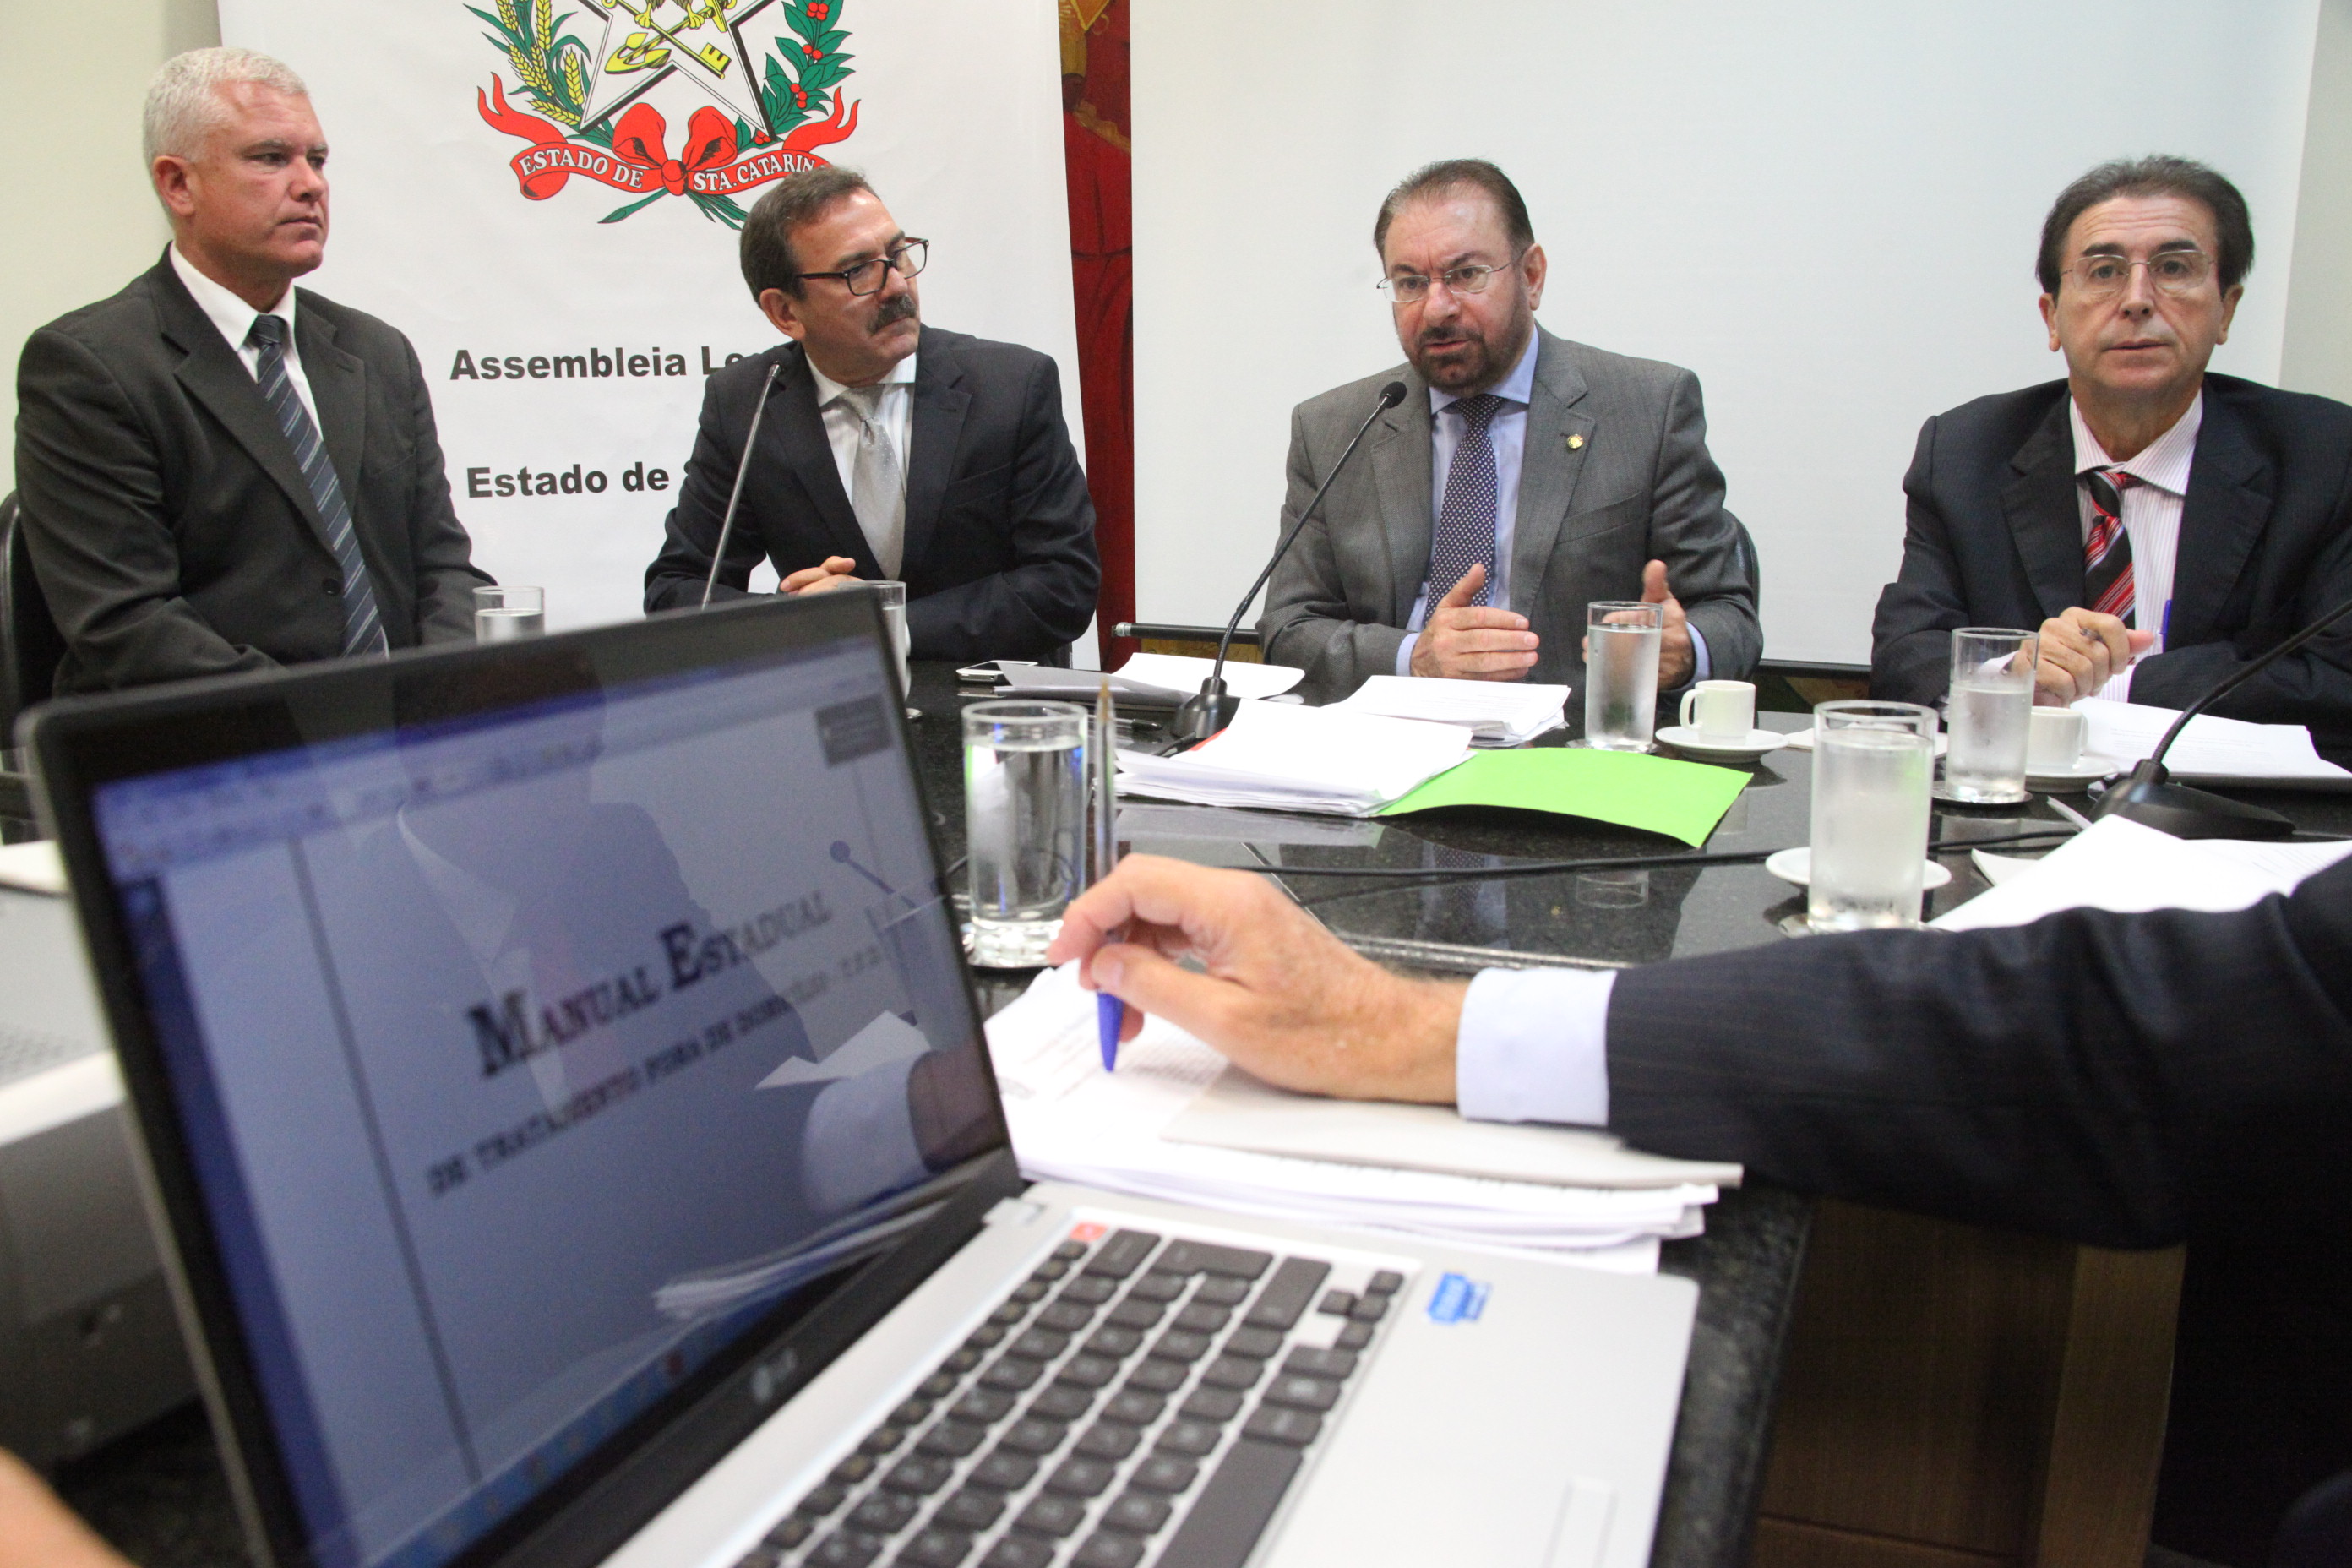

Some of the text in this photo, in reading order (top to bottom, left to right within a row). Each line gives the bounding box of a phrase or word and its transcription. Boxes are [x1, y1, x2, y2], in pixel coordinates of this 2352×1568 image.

[518, 148, 816, 191] ESTADO DE STA. CATARIN
[449, 346, 687, 381] Assembleia
[466, 461, 670, 498] Estado de
